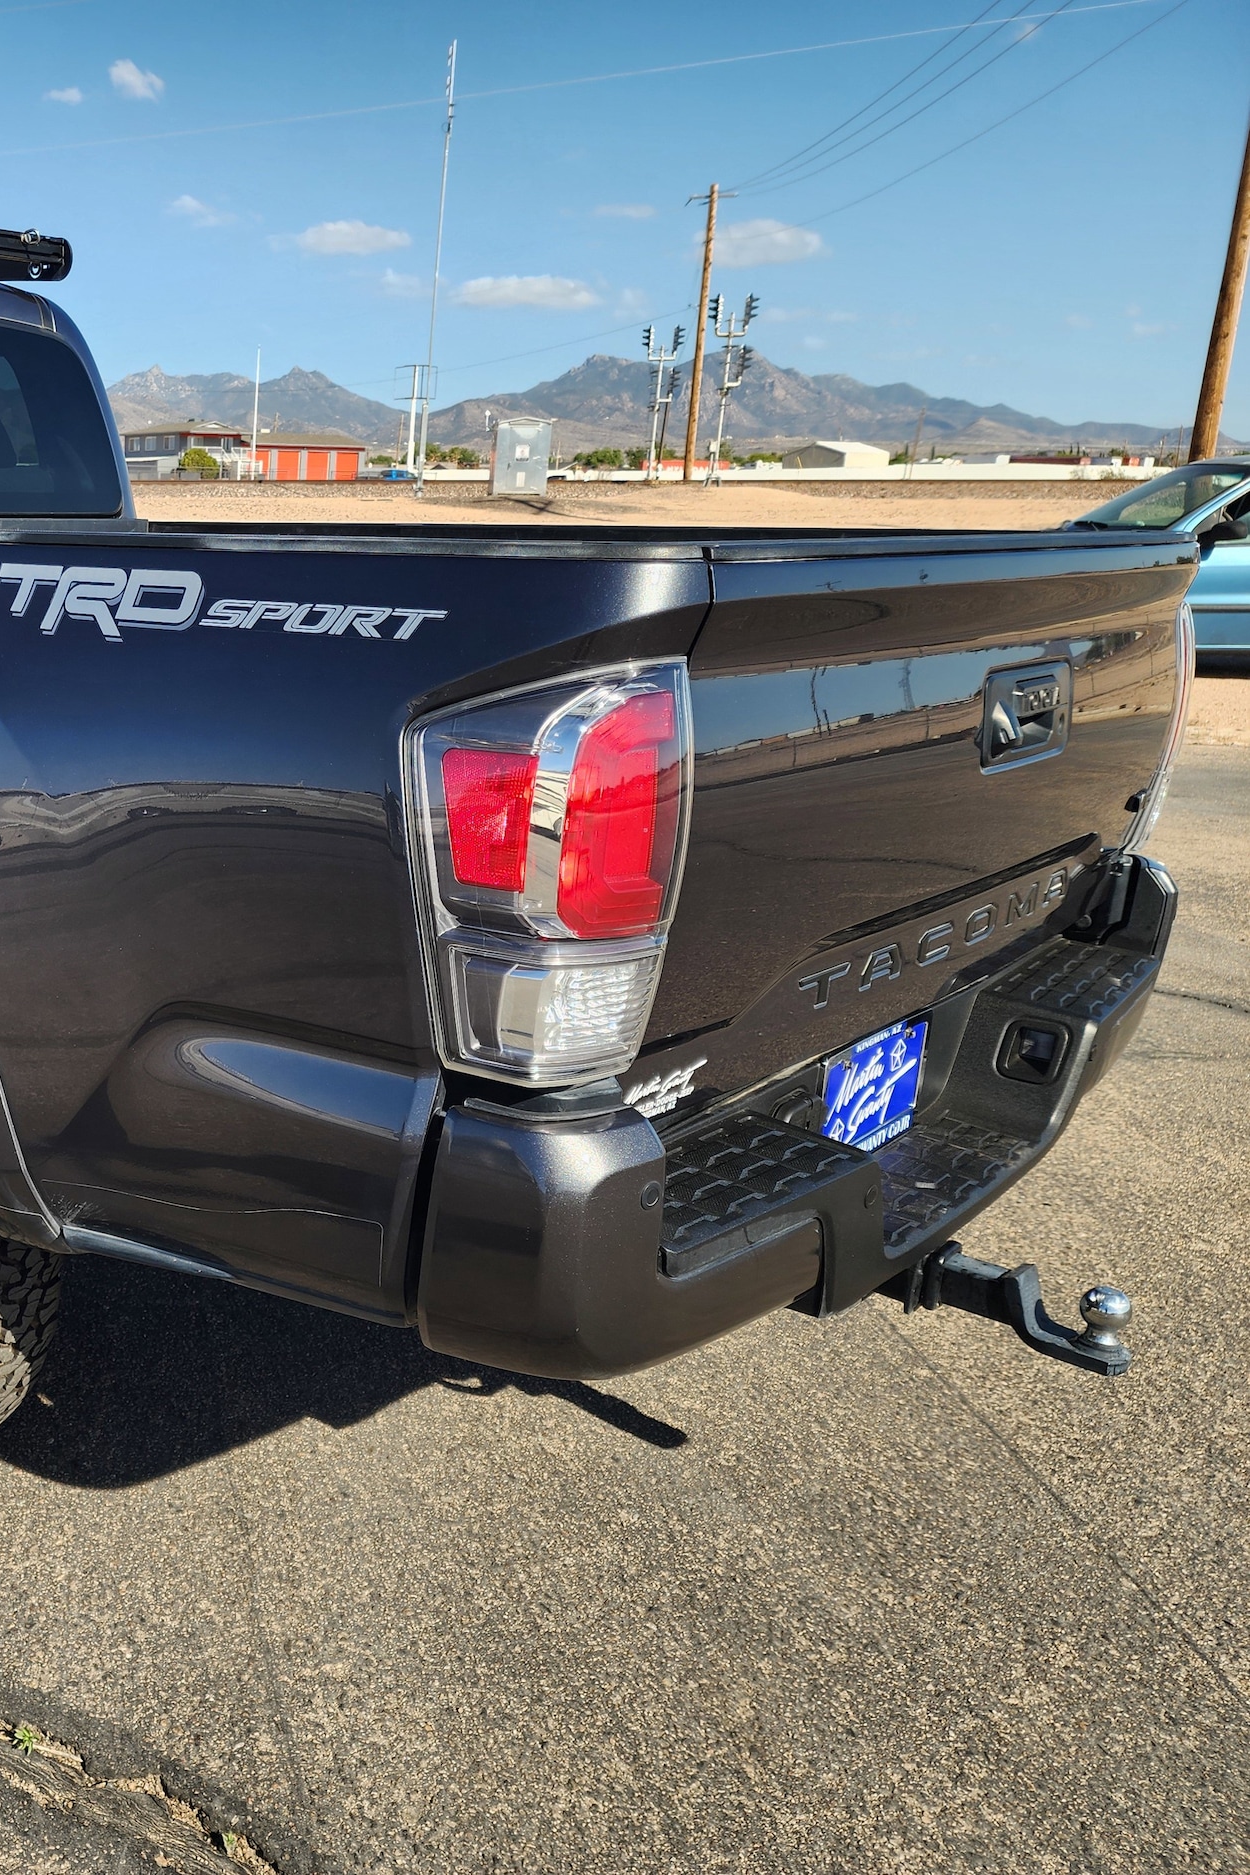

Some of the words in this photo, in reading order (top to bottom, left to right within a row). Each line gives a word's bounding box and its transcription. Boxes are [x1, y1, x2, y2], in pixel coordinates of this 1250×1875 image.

[198, 598, 448, 641] SPORT
[798, 867, 1068, 1010] TACOMA
[890, 1023, 904, 1036] AZ
[823, 1046, 885, 1128] Martin
